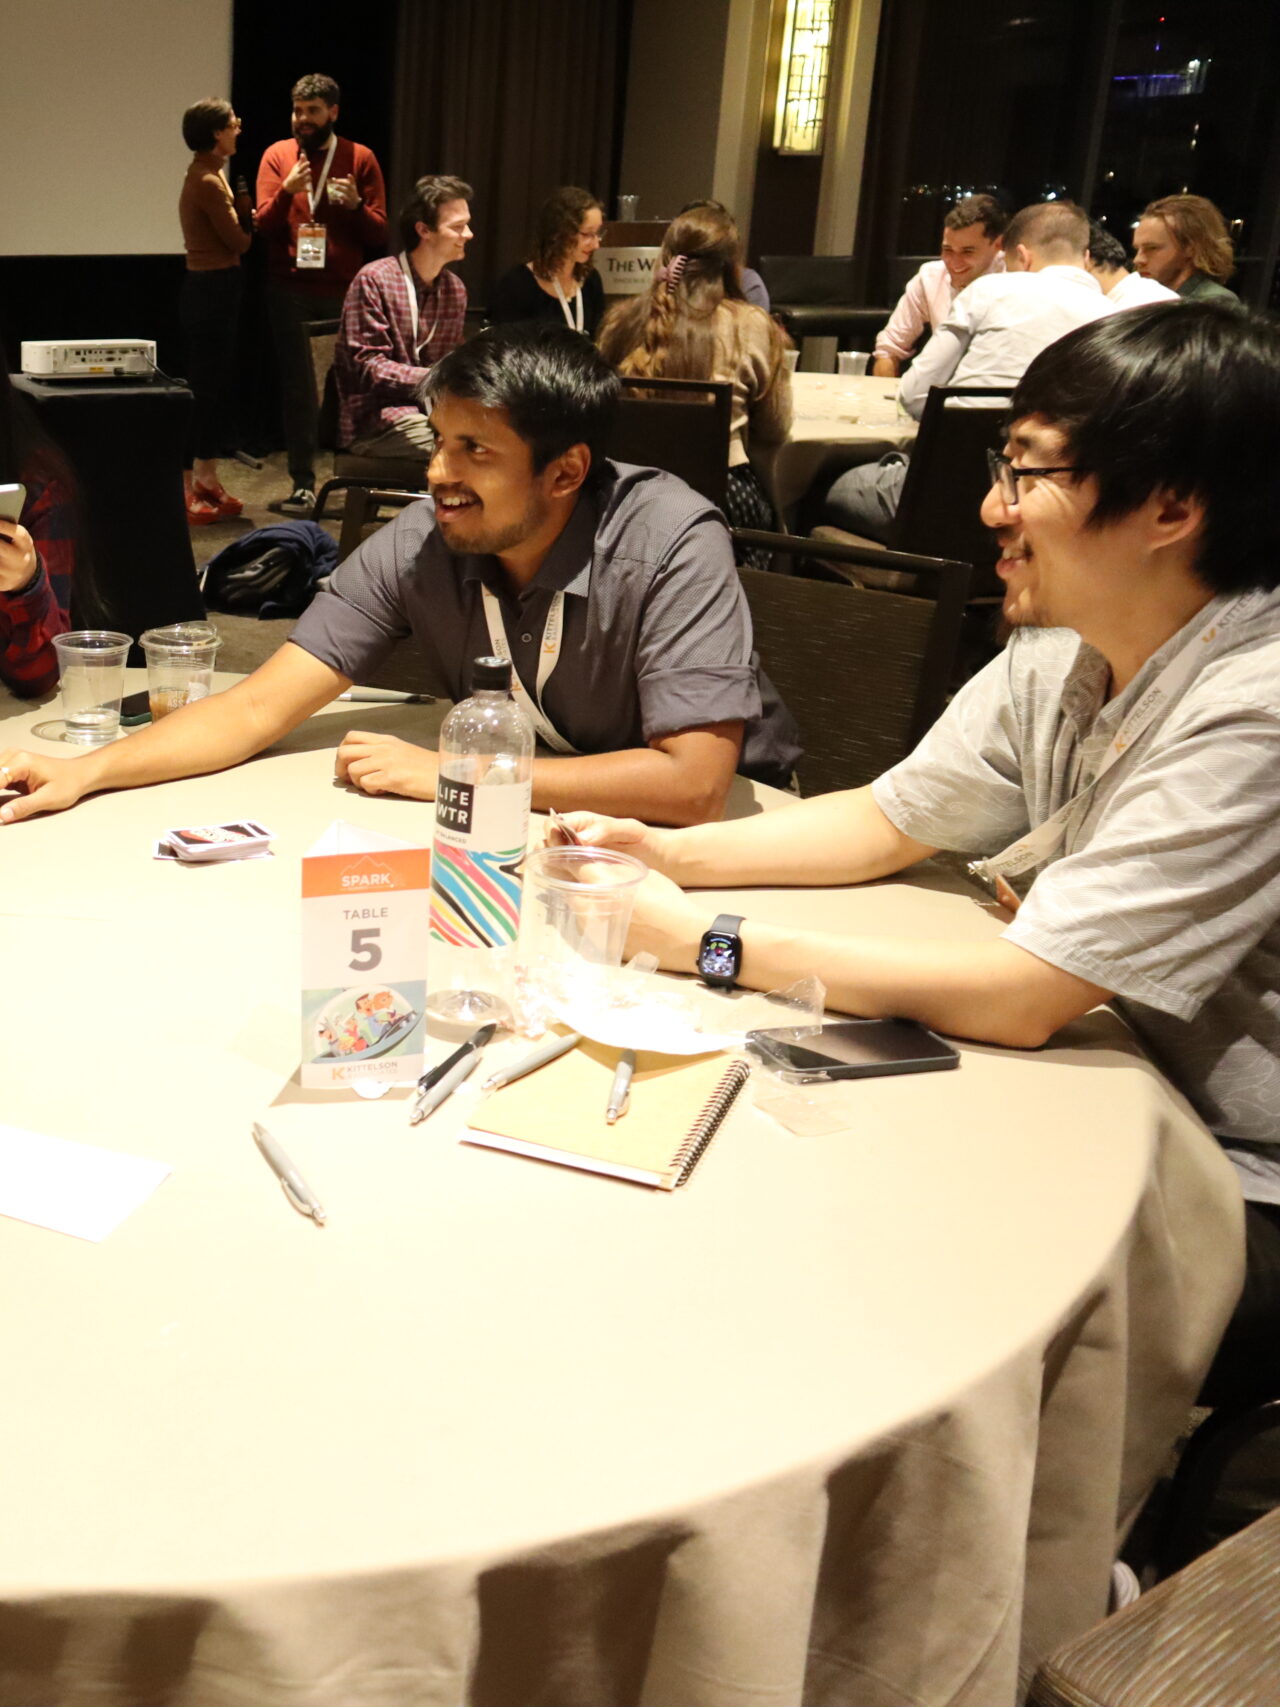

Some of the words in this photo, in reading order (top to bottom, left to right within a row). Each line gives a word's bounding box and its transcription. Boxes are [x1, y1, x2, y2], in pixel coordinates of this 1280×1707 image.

[438, 783, 470, 806] LIFE
[341, 872, 391, 888] SPARK
[343, 906, 389, 920] TABLE
[348, 927, 383, 972] 5
